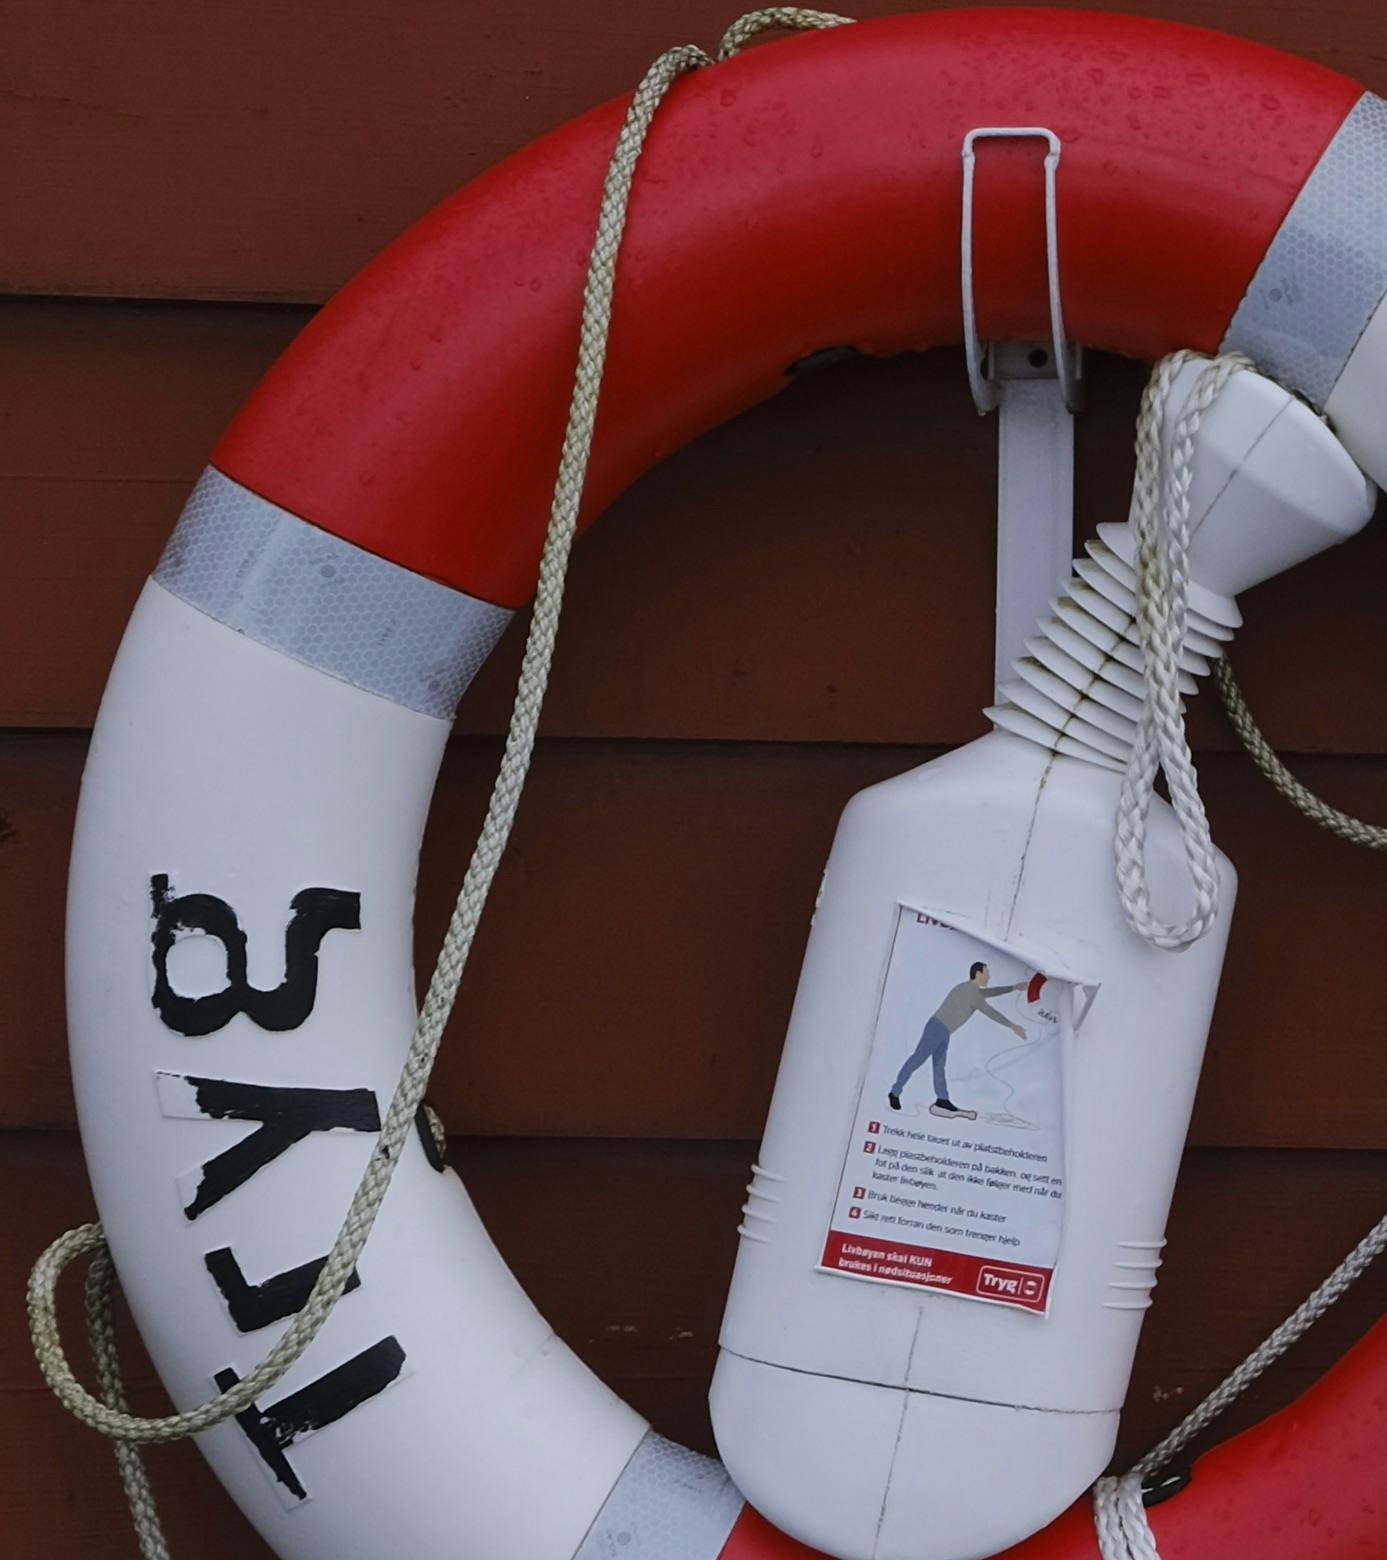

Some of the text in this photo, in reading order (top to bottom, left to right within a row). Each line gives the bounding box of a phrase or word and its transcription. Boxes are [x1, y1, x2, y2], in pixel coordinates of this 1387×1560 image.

[883, 1125, 905, 1138] Trekk
[906, 1130, 926, 1141] hele
[951, 1139, 961, 1147] ut
[962, 1141, 973, 1149] av
[872, 1171, 898, 1183] kaster
[875, 1158, 887, 1167] fot
[887, 1162, 900, 1172] på
[901, 1163, 918, 1173] den
[948, 1170, 965, 1182] den
[967, 1175, 985, 1186] ikke
[986, 1177, 1012, 1190] følger
[1012, 1183, 1034, 1194] med
[1034, 1187, 1049, 1196] når
[1050, 1189, 1062, 1200] du
[877, 1145, 898, 1158] Legg
[971, 1162, 983, 1173] på
[1020, 1172, 1031, 1182] og
[1033, 1174, 1050, 1183] sett
[1051, 1178, 1062, 1186] en
[150, 872, 407, 1501] Tryg
[867, 1190, 888, 1202] Bruk
[889, 1194, 916, 1208] begge
[918, 1199, 948, 1213] hender
[950, 1205, 966, 1215] når
[966, 1208, 979, 1218] du
[979, 1210, 1007, 1223] kaster
[862, 1210, 879, 1221] Sikt
[925, 1222, 943, 1232] den
[944, 1226, 963, 1235] som
[965, 1228, 996, 1242] trenger
[998, 1234, 1021, 1247] hjelp
[838, 1256, 872, 1272] brukes
[878, 1265, 953, 1285] nødsituasjoner
[841, 1243, 933, 1267] Livbøyen skal KUN
[983, 1272, 1019, 1294] Tryg
